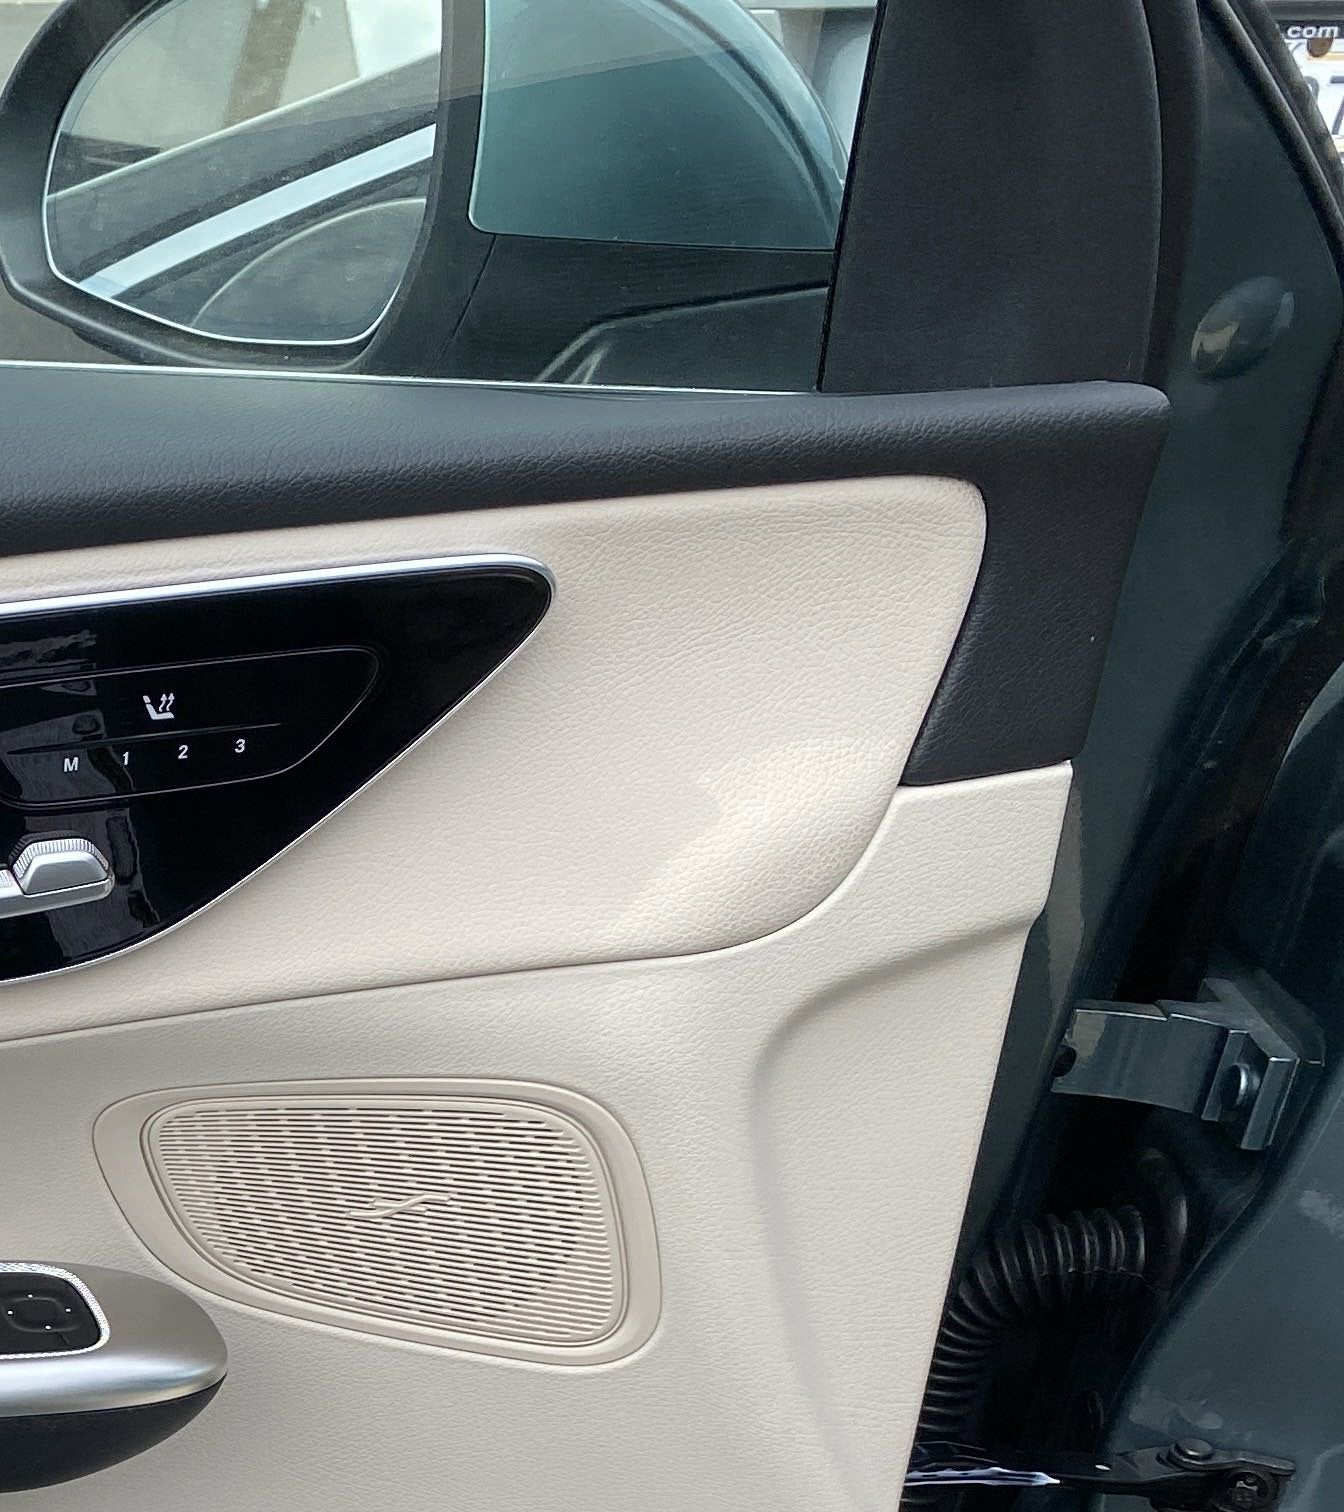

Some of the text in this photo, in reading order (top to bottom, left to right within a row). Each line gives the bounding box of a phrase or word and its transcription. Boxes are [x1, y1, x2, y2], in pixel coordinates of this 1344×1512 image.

[63, 738, 246, 772] M 1 2 3
